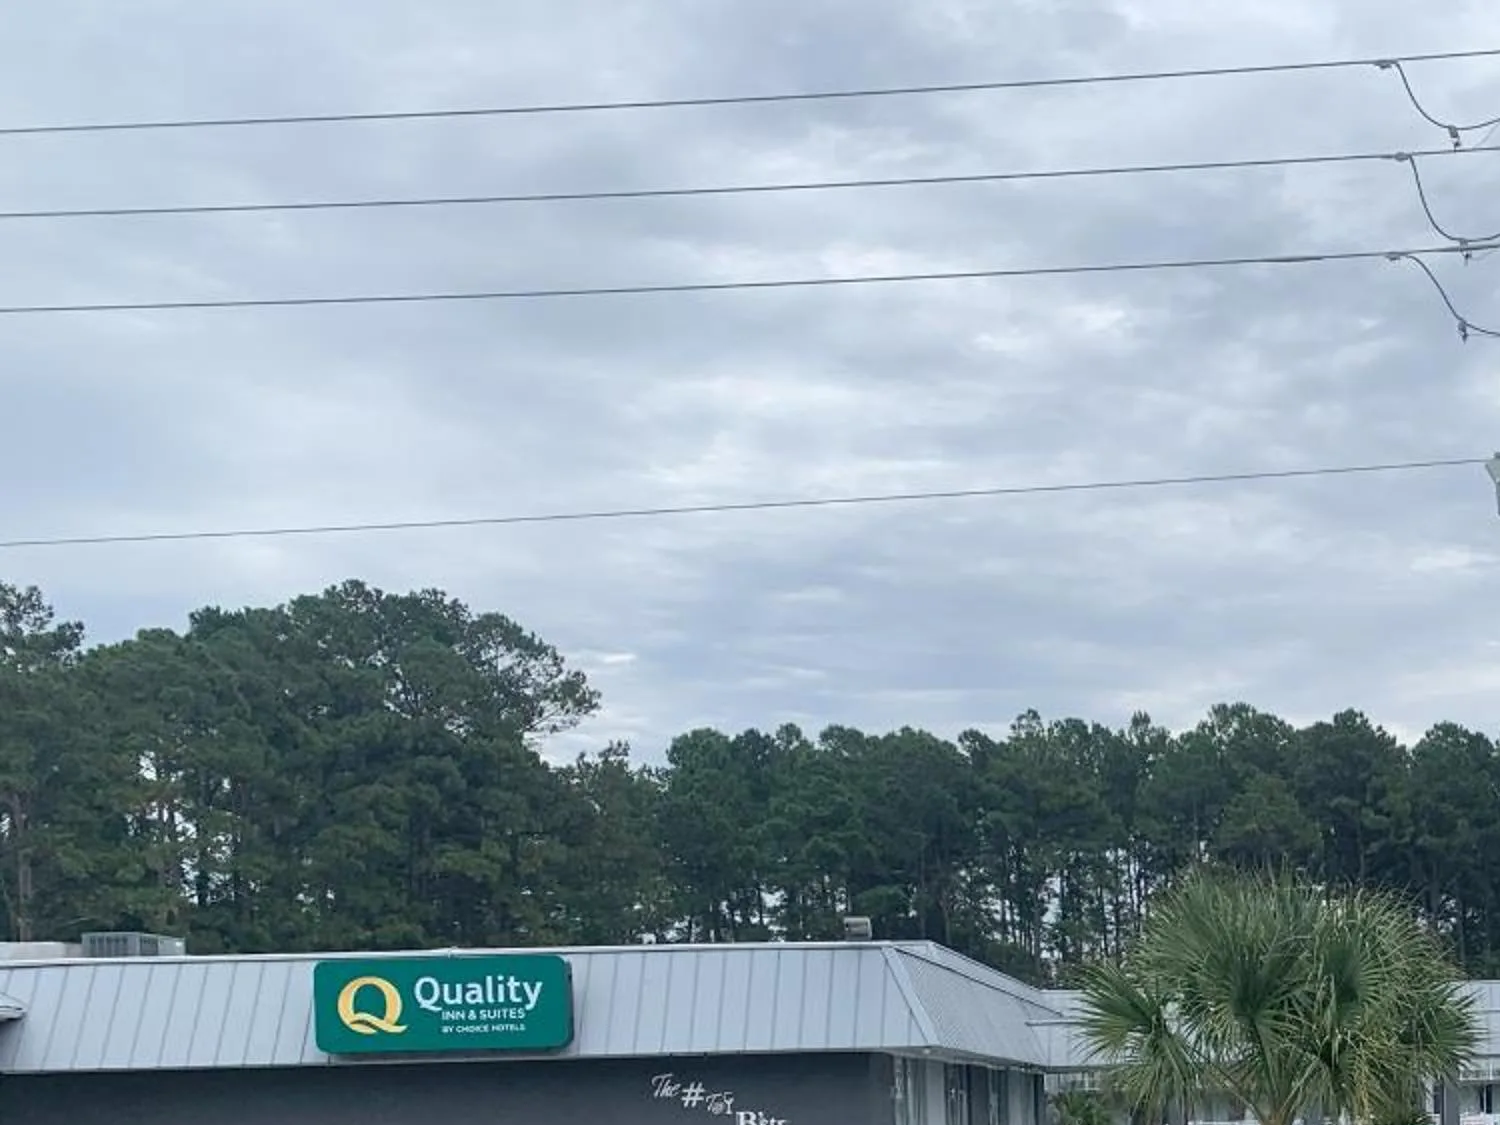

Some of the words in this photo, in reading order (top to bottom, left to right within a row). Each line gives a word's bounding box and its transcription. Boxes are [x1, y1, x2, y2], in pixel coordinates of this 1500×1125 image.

[337, 976, 408, 1034] Q
[414, 975, 543, 1011] Quality
[441, 1010, 466, 1021] INN
[467, 1009, 477, 1020] &
[479, 1007, 526, 1020] SUITES
[442, 1025, 454, 1033] BY
[455, 1024, 490, 1033] CHOICE
[491, 1023, 526, 1031] HOTELS
[651, 1073, 681, 1098] The
